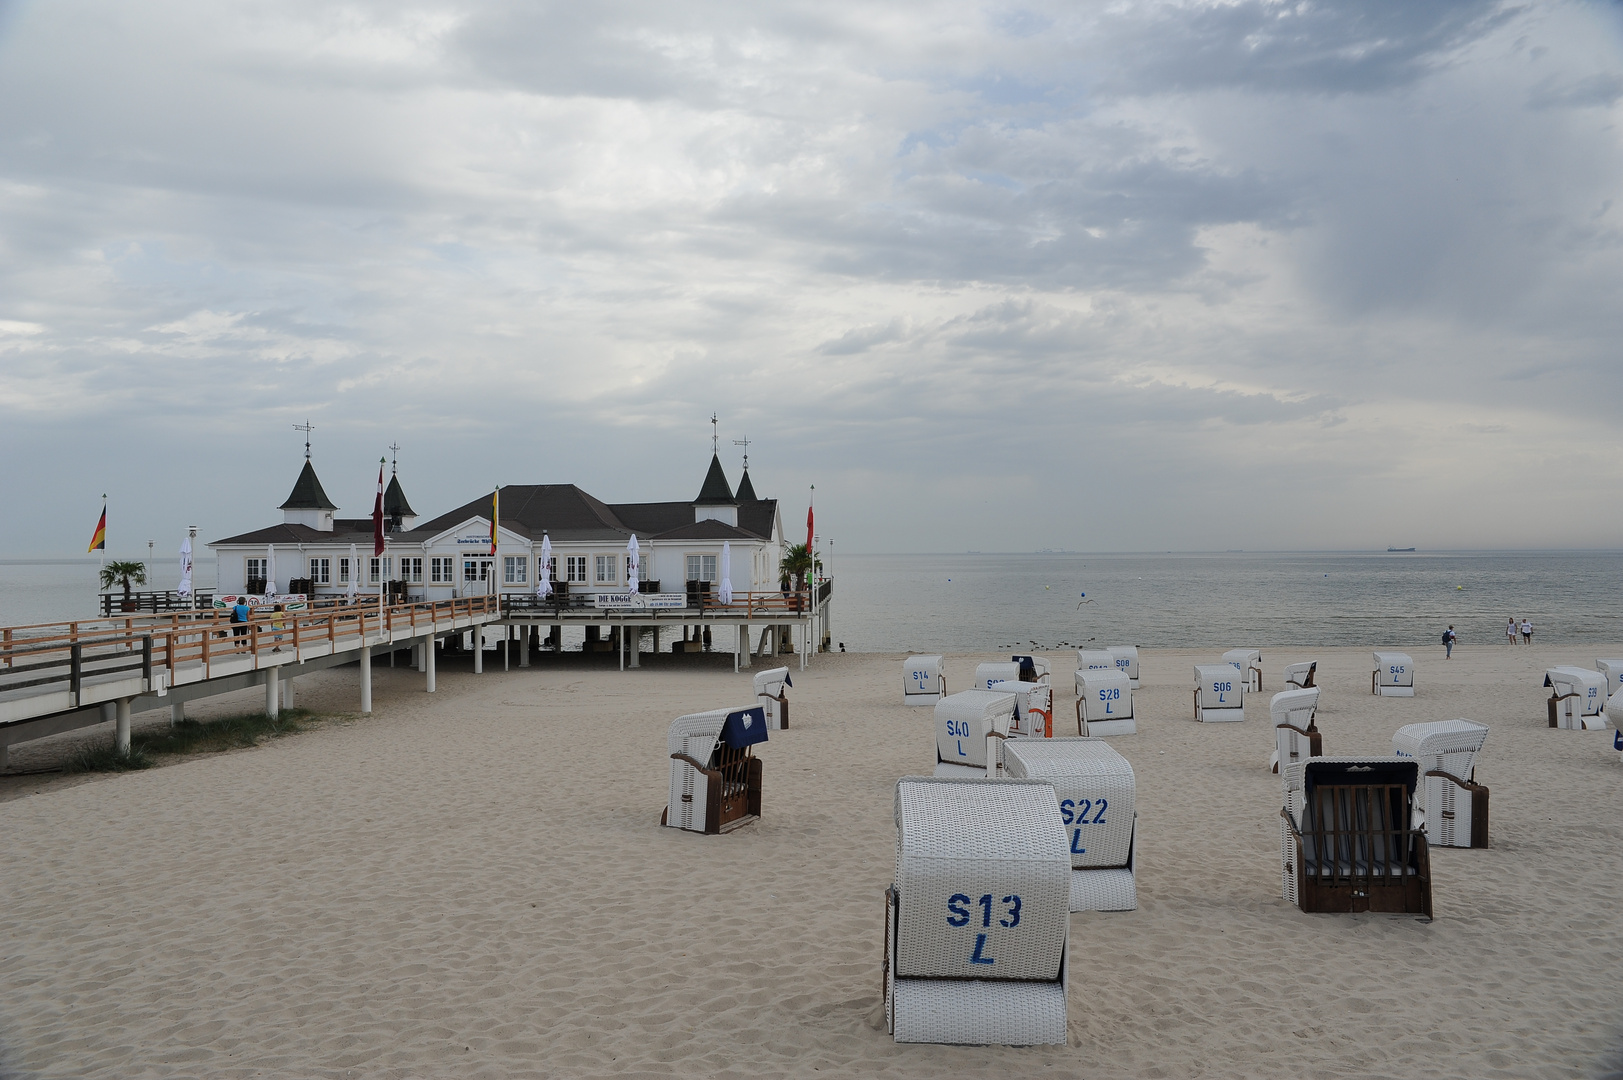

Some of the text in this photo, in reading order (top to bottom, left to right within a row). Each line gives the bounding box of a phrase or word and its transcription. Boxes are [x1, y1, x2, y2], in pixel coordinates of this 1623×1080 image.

[598, 595, 609, 603] DIE
[1116, 659, 1130, 667] S08
[1390, 665, 1405, 674] S45
[912, 671, 929, 681] S14
[1394, 674, 1400, 683] L
[919, 680, 925, 690] L
[1213, 681, 1232, 692] S06
[1099, 688, 1120, 701] S28
[1218, 693, 1226, 703] L
[1105, 702, 1113, 714] L
[946, 719, 970, 738] S40
[957, 739, 967, 757] L
[1060, 798, 1109, 826] S22
[1070, 827, 1086, 855] L
[946, 893, 1023, 929] S13
[969, 932, 995, 966] L
